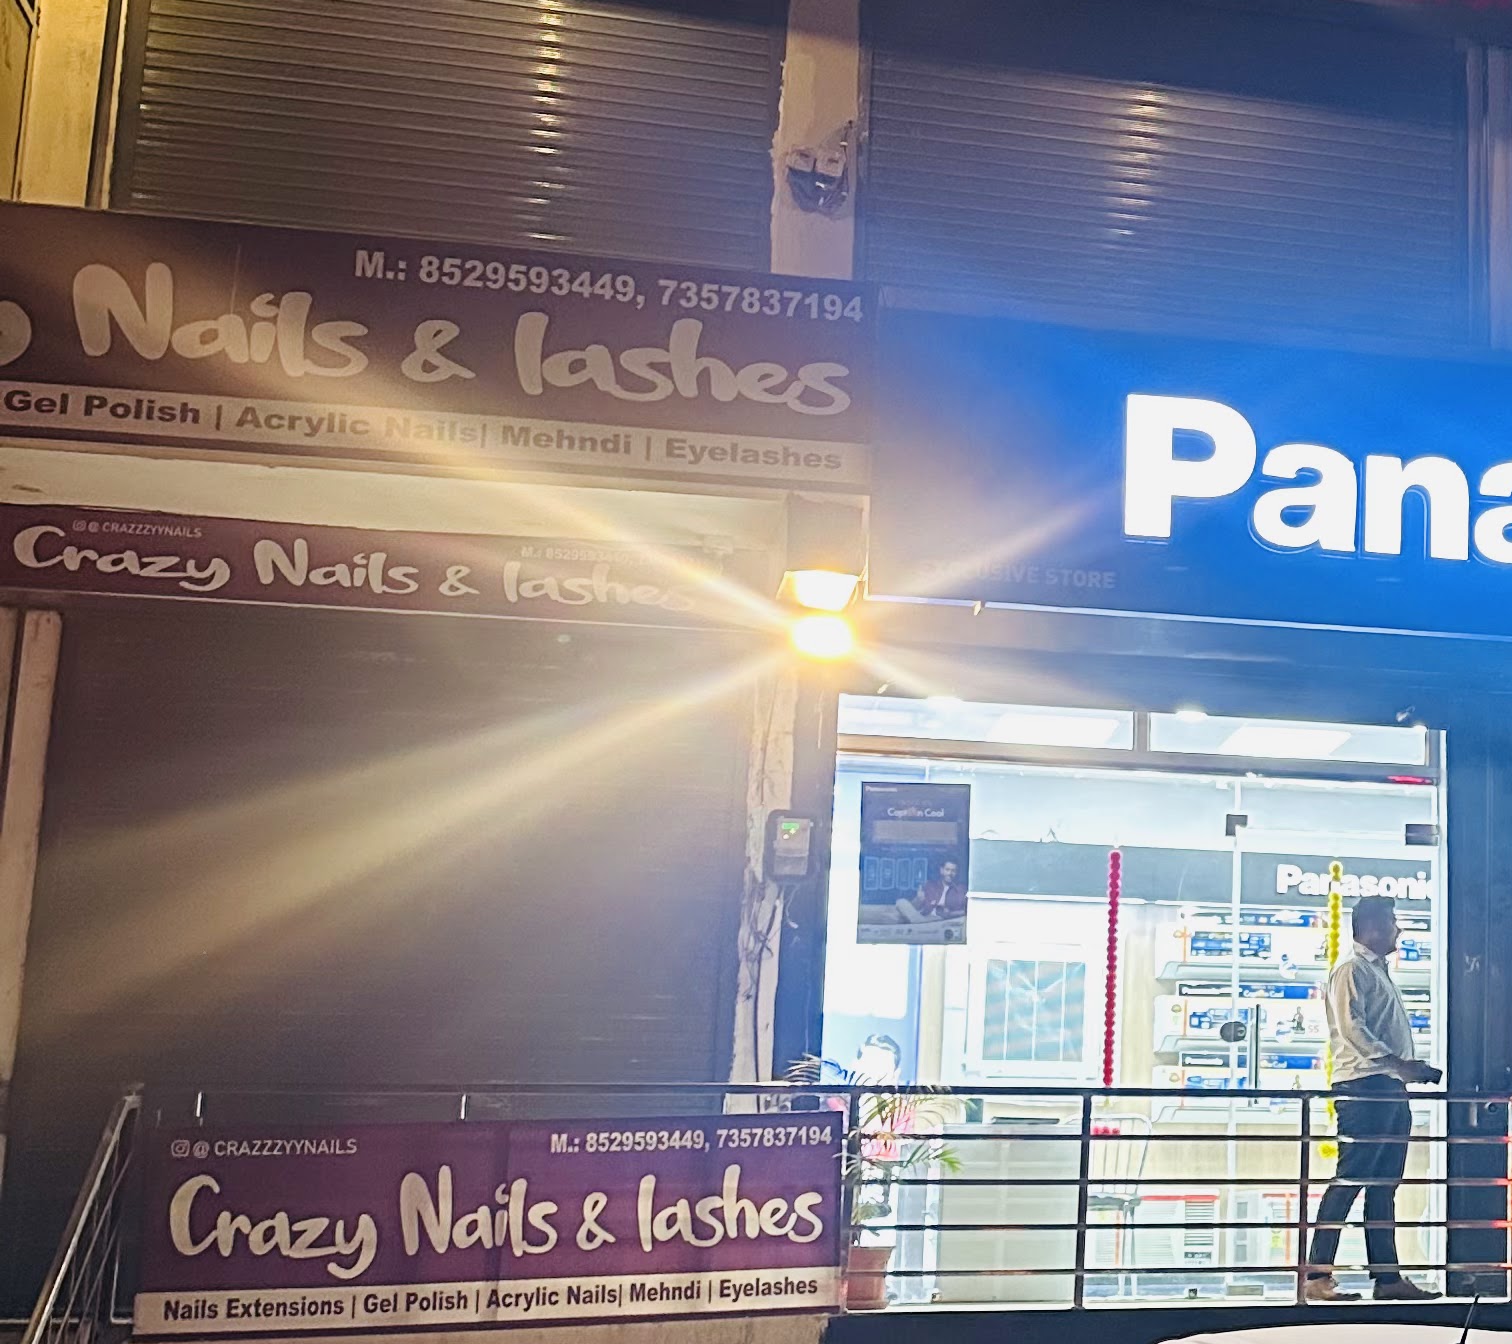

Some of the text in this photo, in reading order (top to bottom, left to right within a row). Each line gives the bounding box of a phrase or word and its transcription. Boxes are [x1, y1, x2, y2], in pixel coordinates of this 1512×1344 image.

[419, 255, 646, 309] 8529593449,
[658, 277, 864, 324] 7357837194
[72, 262, 369, 378] Nails
[400, 318, 476, 383] &
[514, 311, 852, 416] lashes
[3, 388, 70, 416] Gel
[83, 393, 202, 425] Polish
[236, 406, 370, 443] Acrylic
[501, 425, 632, 458] Mehndi
[664, 438, 843, 474] Eyelashes
[103, 522, 203, 538] CRAZZZYYNAILS
[13, 525, 696, 611] Crazy Nails & lashes
[1045, 567, 1116, 589] STORE
[214, 1138, 358, 1157] CRAZZZYYNAILS
[585, 1130, 709, 1155] 8529593449,
[716, 1126, 833, 1149] 7357837194
[168, 1164, 825, 1280] Crazy Nails & lashes
[163, 1299, 219, 1322] Nails
[226, 1295, 345, 1320] Extensions
[363, 1293, 399, 1314] Gel
[405, 1290, 469, 1313] Polish
[487, 1286, 560, 1311] Acrylic
[629, 1280, 702, 1302] Mehndi
[719, 1276, 819, 1303] Eyelashes
